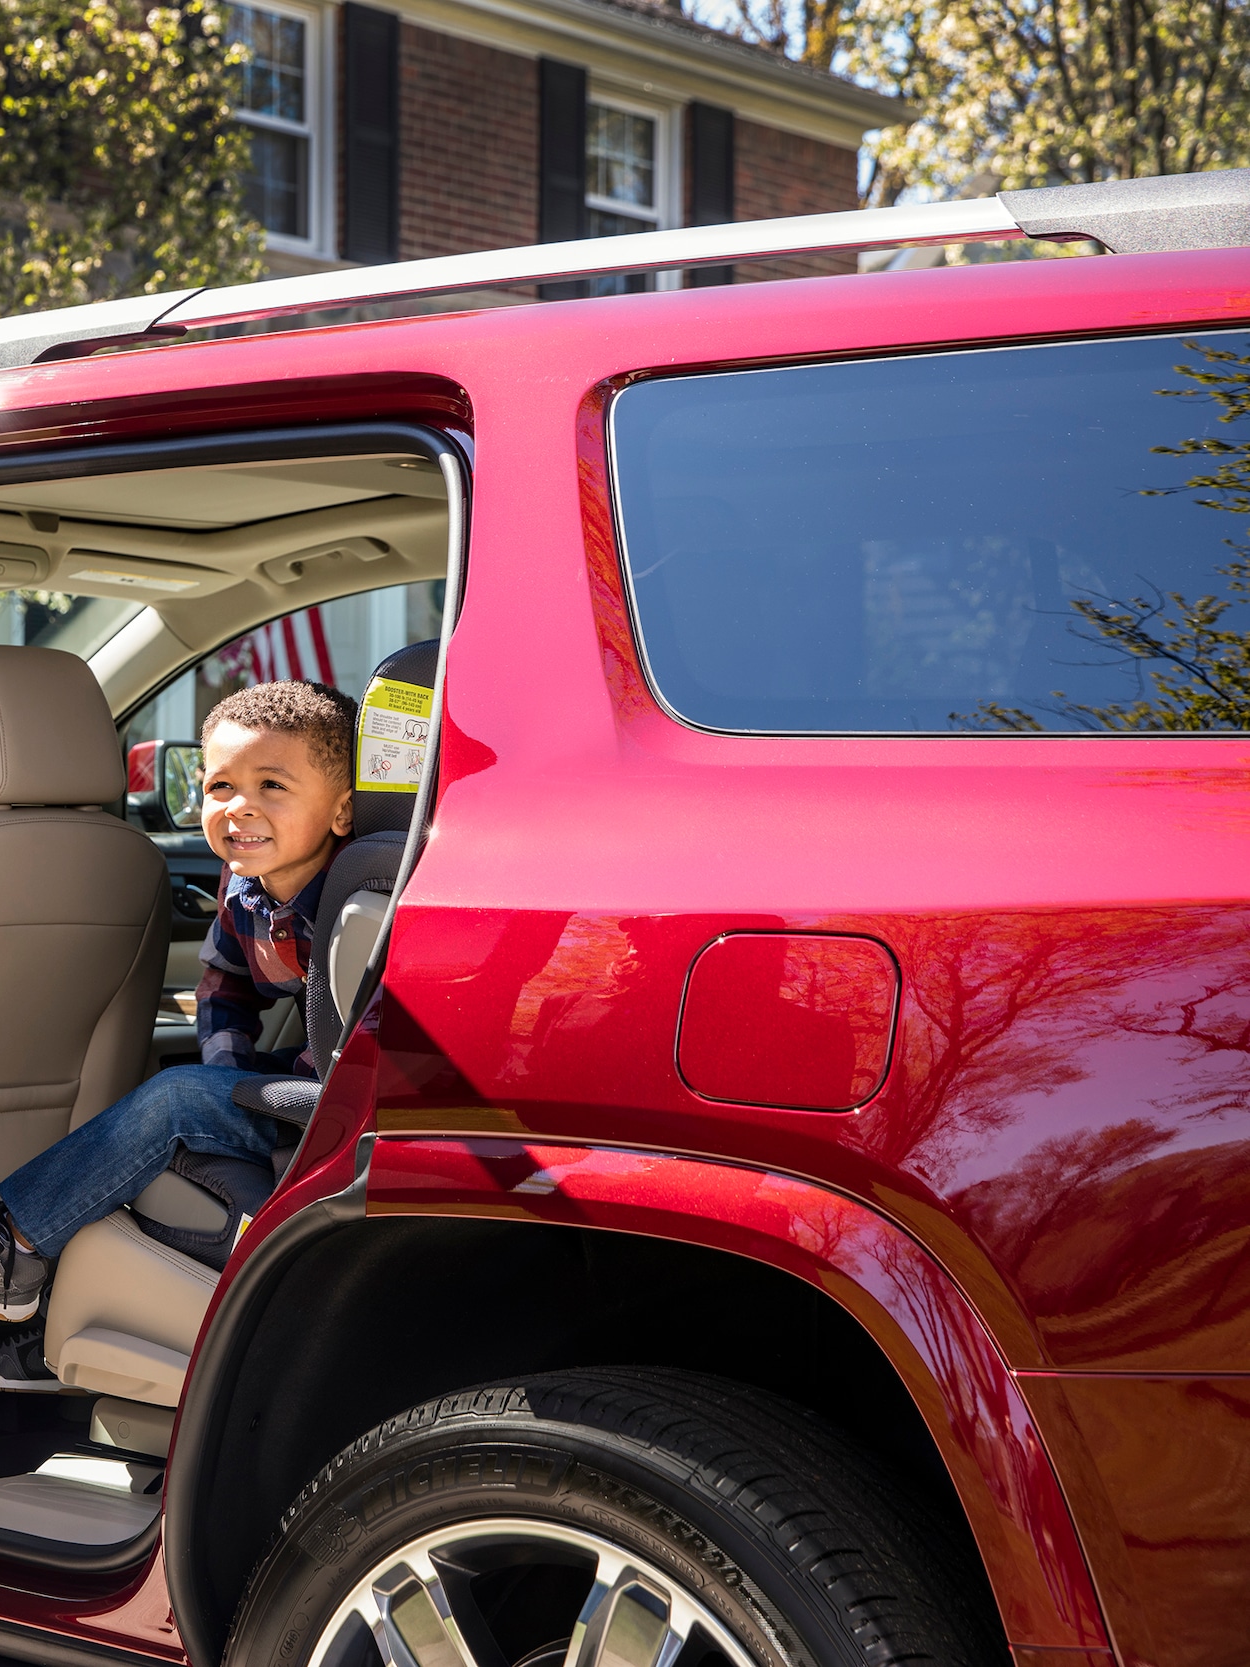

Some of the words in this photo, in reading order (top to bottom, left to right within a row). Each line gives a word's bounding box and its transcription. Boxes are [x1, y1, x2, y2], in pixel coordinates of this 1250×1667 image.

[418, 692, 429, 700] BACK
[360, 1452, 556, 1523] MICHELIN
[592, 1509, 619, 1528] TPC
[619, 1522, 650, 1545] SPEC
